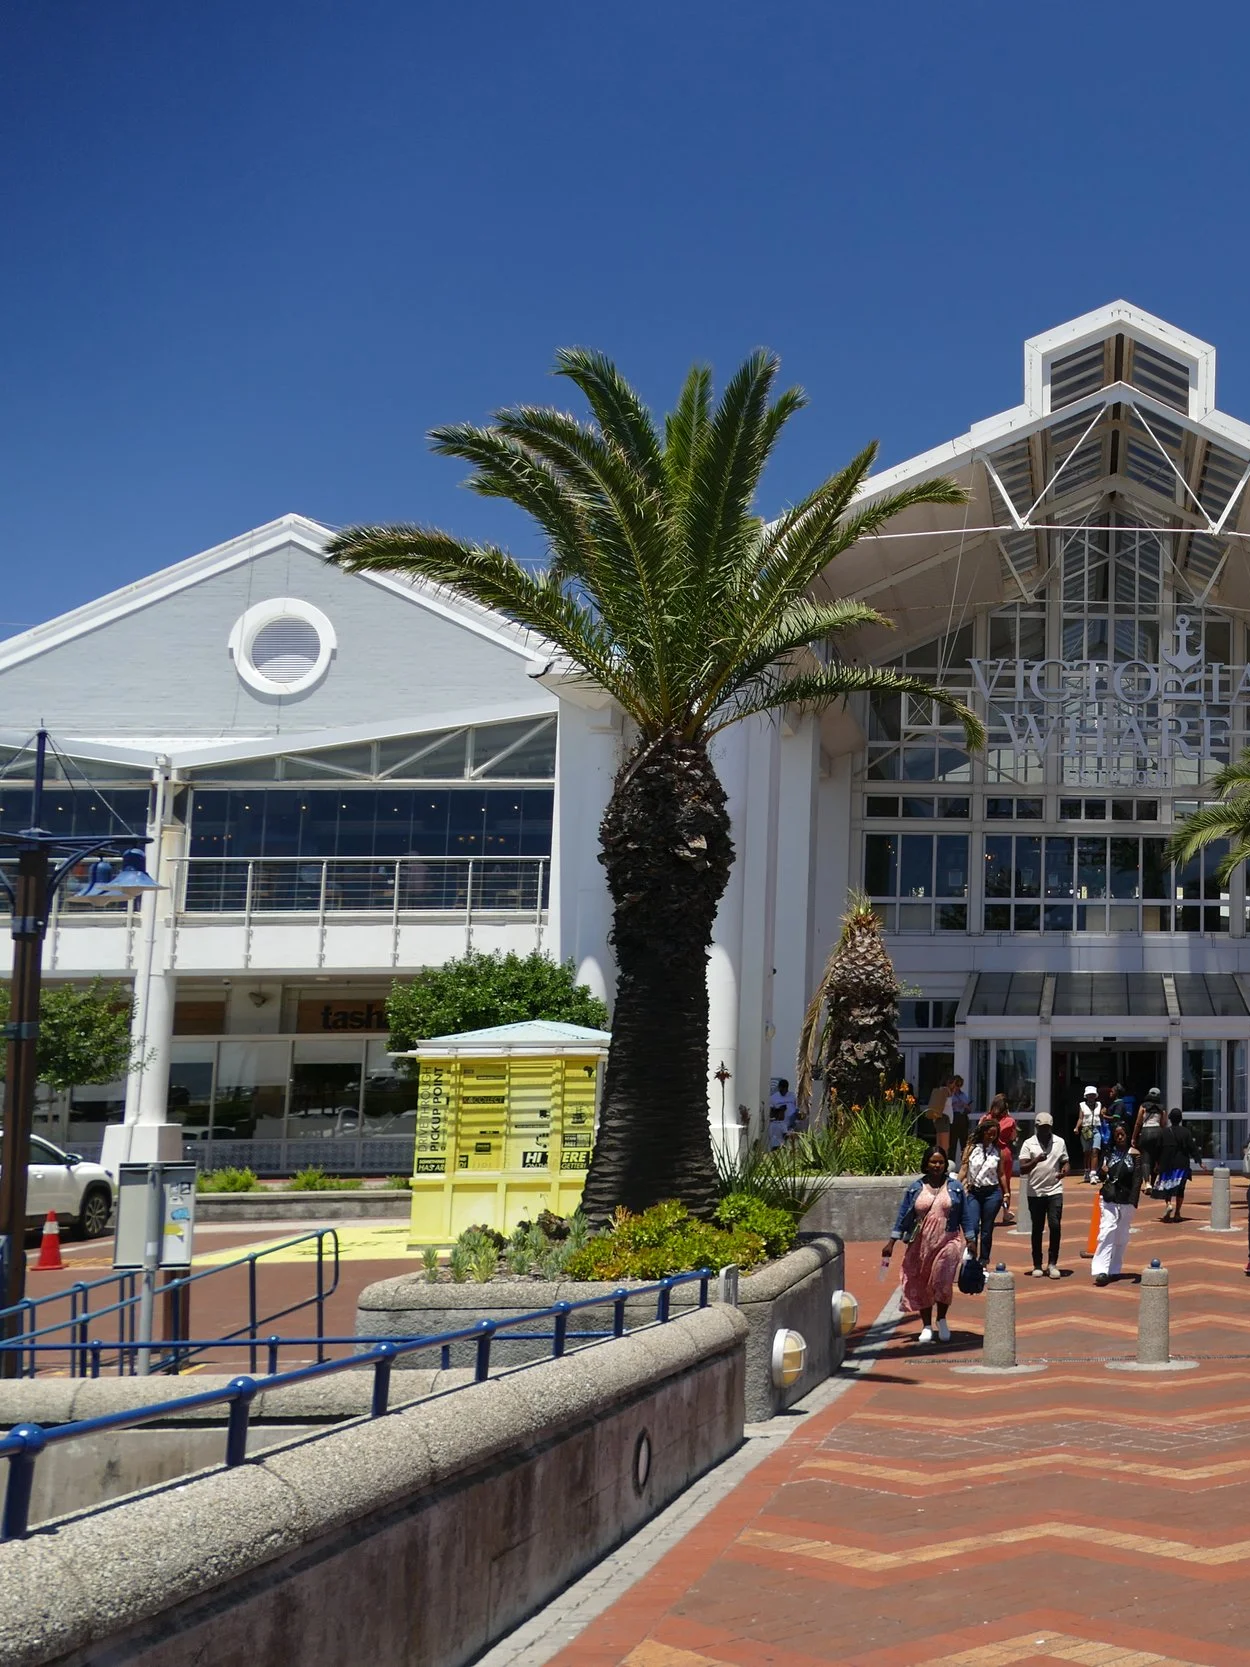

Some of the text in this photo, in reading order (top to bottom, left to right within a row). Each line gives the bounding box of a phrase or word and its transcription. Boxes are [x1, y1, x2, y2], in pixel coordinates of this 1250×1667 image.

[999, 713, 1231, 760] WHARF
[418, 1066, 432, 1152] DRIVE THROUGH
[430, 1067, 444, 1152] PICKUP POINT
[525, 1152, 542, 1164] HI
